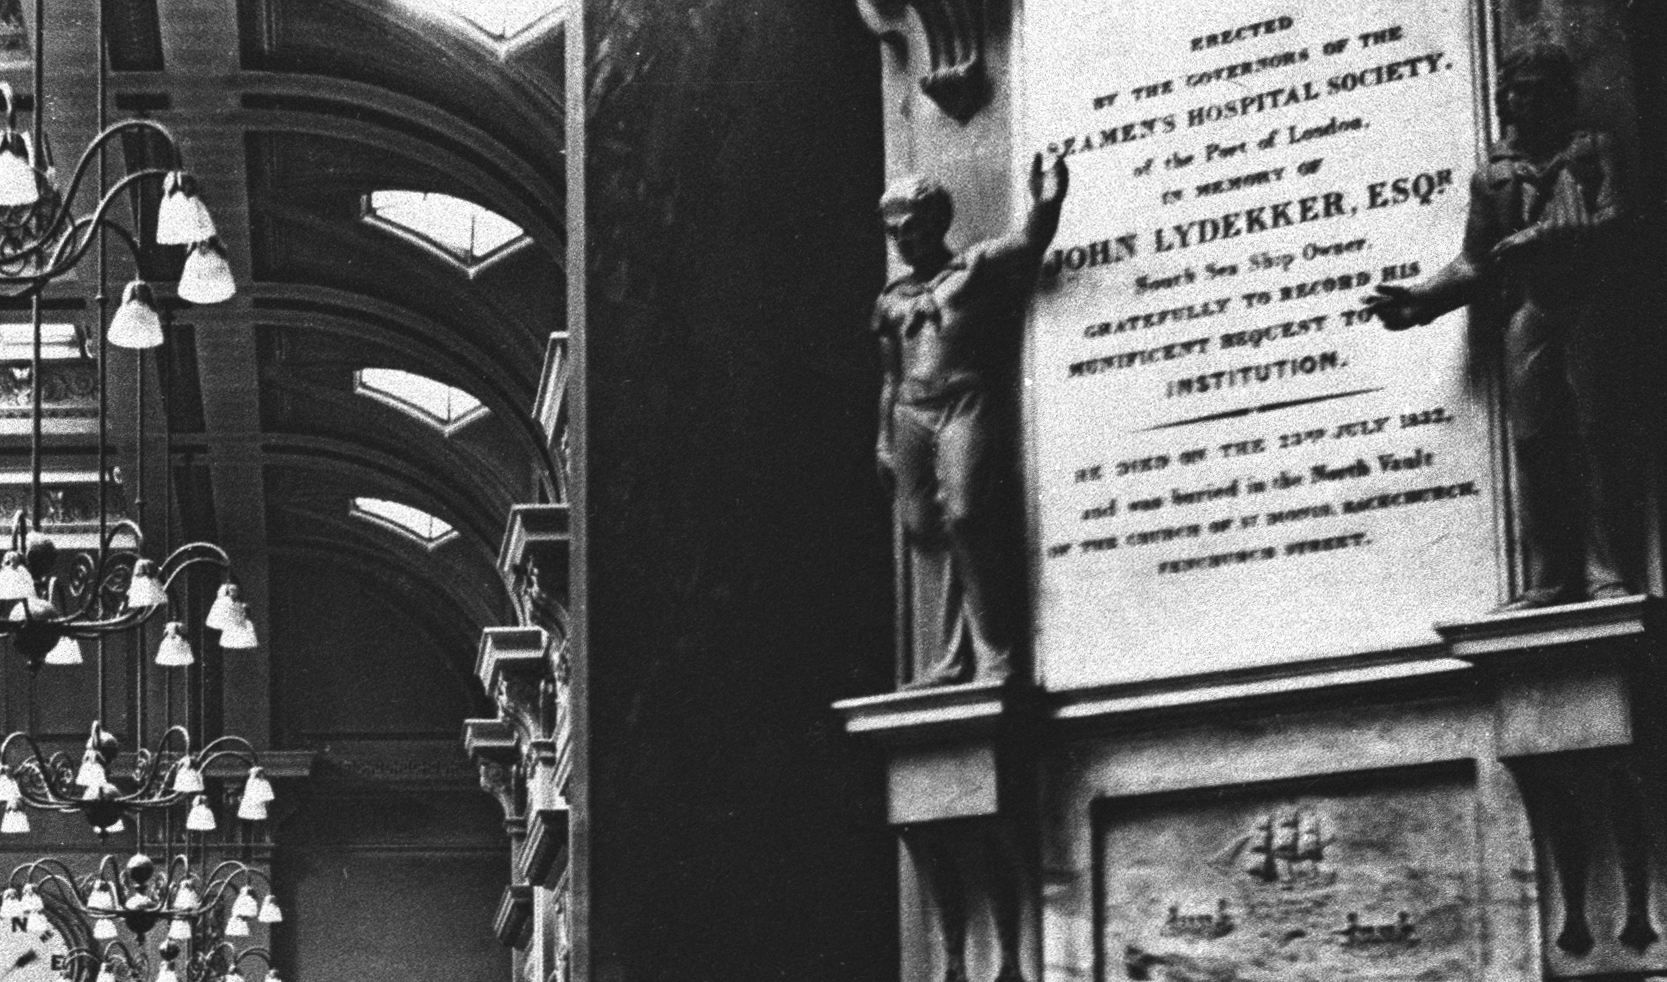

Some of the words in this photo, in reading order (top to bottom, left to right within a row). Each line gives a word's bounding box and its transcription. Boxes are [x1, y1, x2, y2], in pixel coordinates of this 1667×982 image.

[1191, 16, 1294, 51] ERECTED
[1093, 92, 1119, 111] BY
[1131, 80, 1174, 102] THE
[1186, 48, 1310, 87] GOVERNORS
[1323, 38, 1350, 56] OF
[1358, 26, 1403, 48] THE
[1188, 81, 1320, 128] HOSPITAL
[1327, 52, 1453, 95] SOCIETY.
[1257, 129, 1280, 150] of
[1196, 166, 1286, 198] MEMORY
[1044, 233, 1137, 272] JOHN
[1155, 192, 1358, 253] LYDEKKER,
[1084, 297, 1232, 339] GRATEFULLY
[1242, 291, 1272, 309] TO
[1280, 271, 1372, 301] RECORD
[1381, 261, 1421, 283] HIS
[1068, 337, 1211, 378] MUNIFICENT
[1220, 315, 1328, 349] BEQUEST
[1166, 351, 1349, 398] INSTITUTION.
[1220, 438, 1266, 458] THE
[1333, 416, 1390, 439] JULY
[12, 917, 28, 933] N
